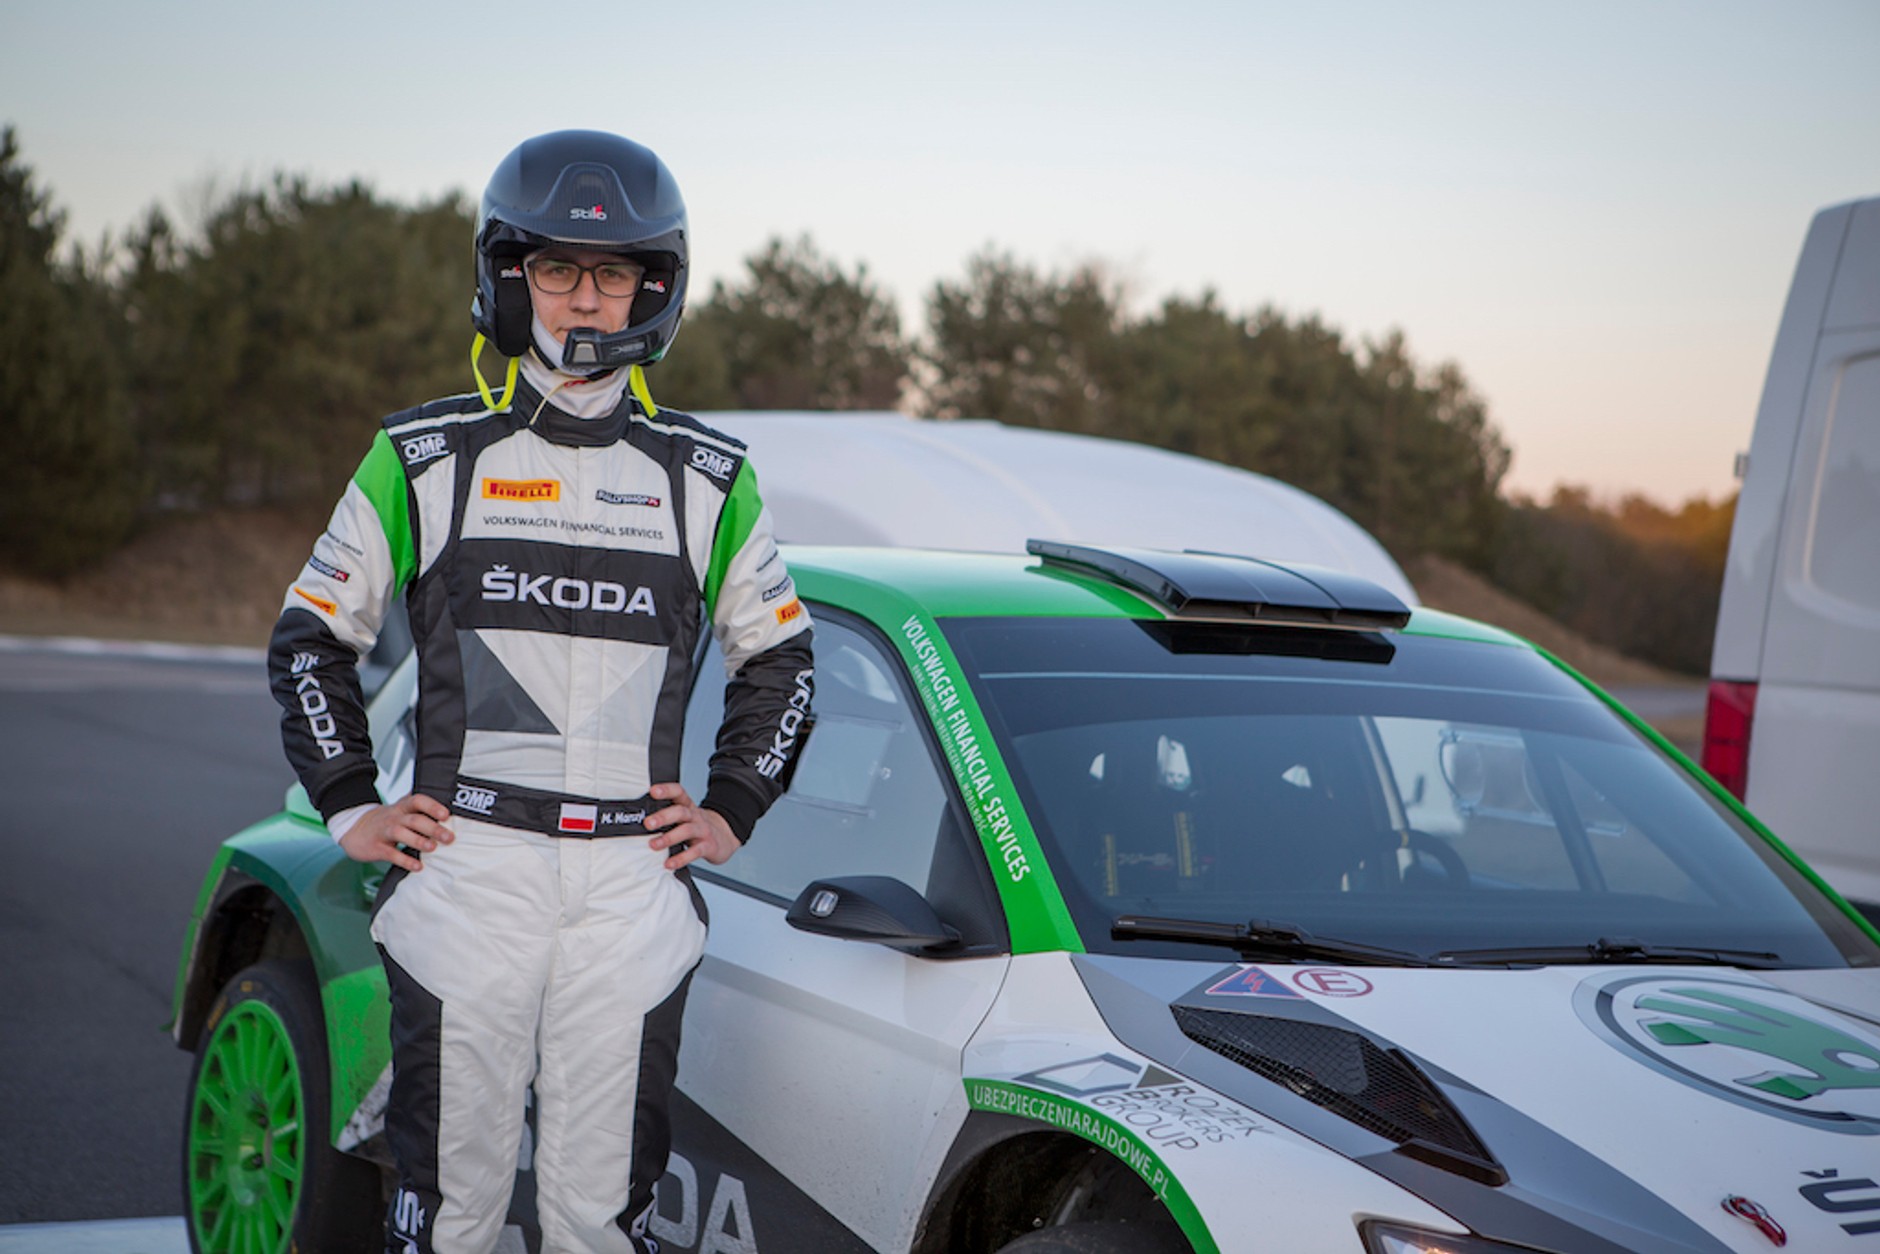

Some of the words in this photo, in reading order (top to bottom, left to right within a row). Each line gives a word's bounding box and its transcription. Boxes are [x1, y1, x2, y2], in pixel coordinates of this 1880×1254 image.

[403, 434, 447, 461] OMP
[691, 448, 734, 478] OMP
[489, 482, 553, 497] PIRELLI
[483, 516, 558, 528] VOLKSWAGEN
[618, 526, 664, 540] SERVICES
[481, 565, 656, 617] ŠKODA
[290, 651, 344, 760] ŠKODA
[755, 669, 814, 779] ŠKODA
[901, 614, 960, 709] VOLKSWAGEN
[947, 709, 995, 800] FINANCIAL
[983, 796, 1031, 883] SERVICES
[454, 787, 497, 812] OMP
[973, 1084, 1170, 1200] UBEZPIECZENIARAJDOWE.PL
[1089, 1094, 1200, 1151] GROUP
[1123, 1089, 1235, 1144] BROKERS
